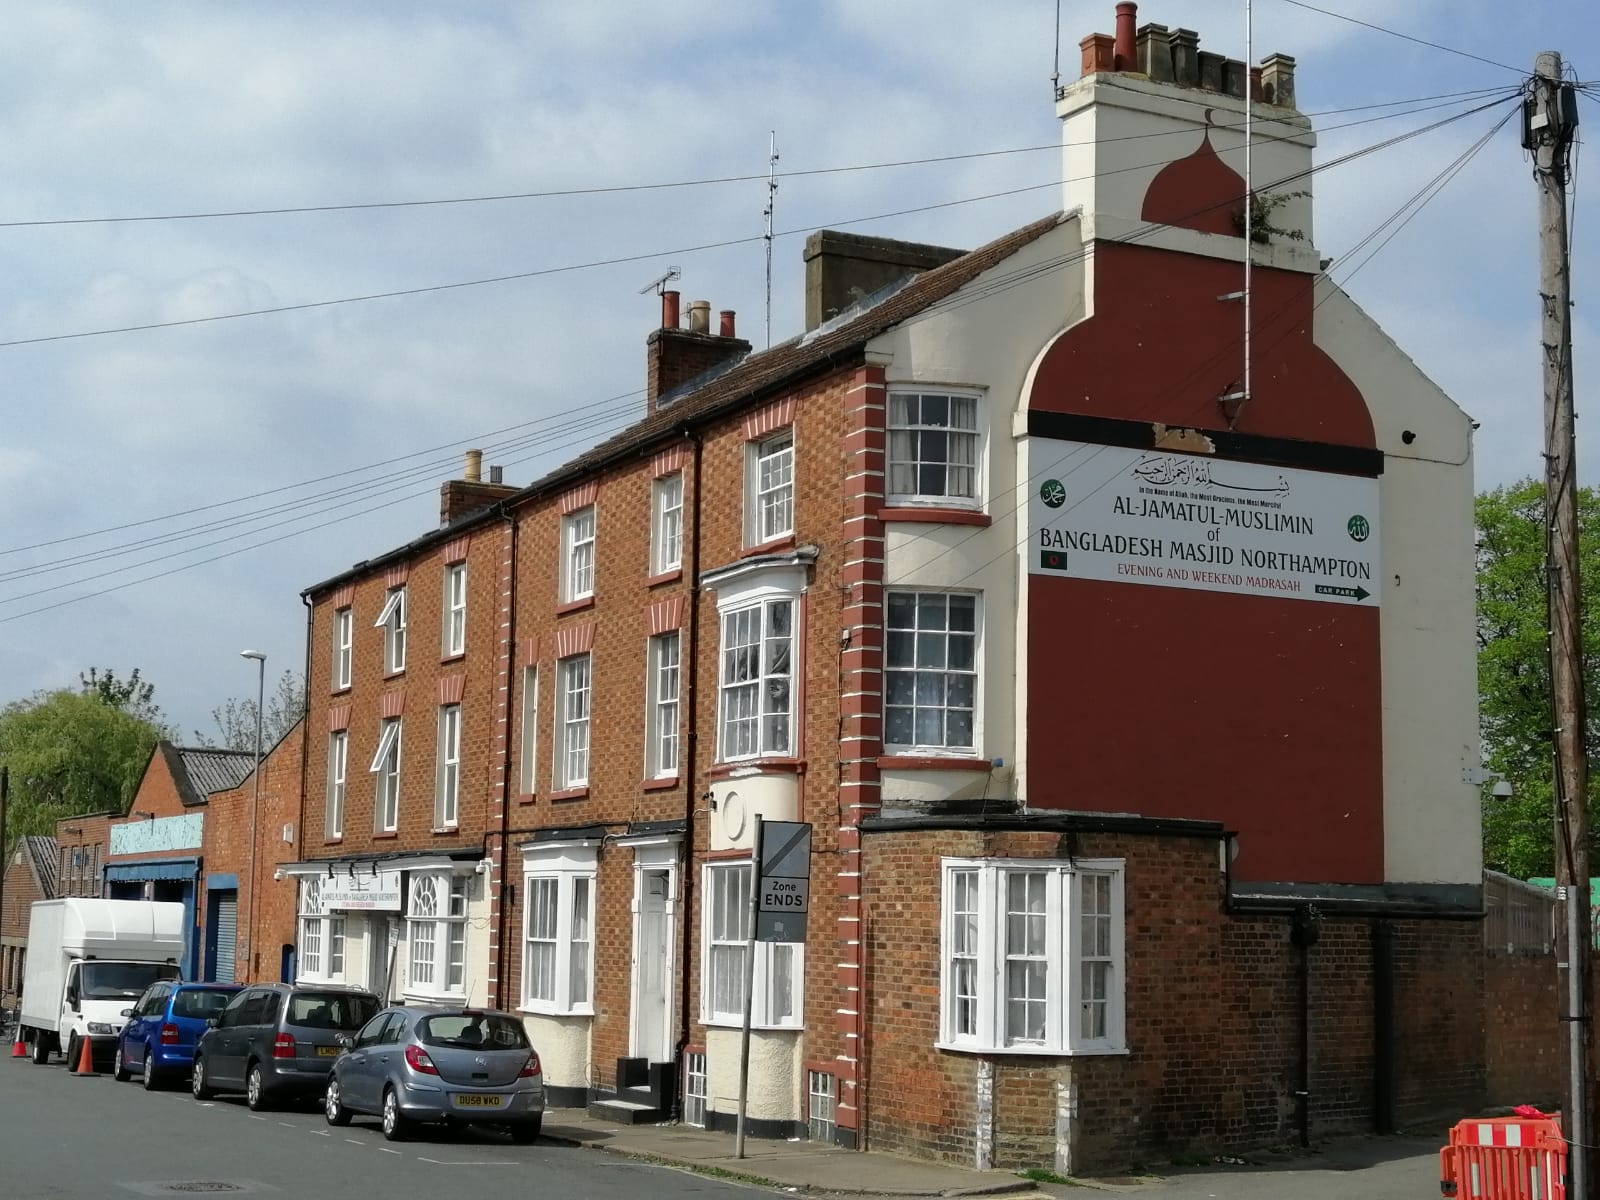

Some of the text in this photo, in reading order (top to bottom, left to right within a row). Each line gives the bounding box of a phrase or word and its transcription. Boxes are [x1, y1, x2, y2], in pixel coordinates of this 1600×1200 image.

[1199, 492, 1211, 501] Most
[1247, 498, 1259, 506] Most
[1113, 495, 1313, 535] AL-JAMATUL-MUSLIMIN
[1207, 528, 1220, 541] of
[1040, 528, 1370, 580] BANGLADESH MASJID NORTHAMPTON
[1118, 563, 1300, 592] EVENING AND WEEKEND MADRASAH
[1318, 586, 1356, 596] CAR PARK
[772, 881, 797, 892] Zone
[765, 893, 803, 906] ENDS
